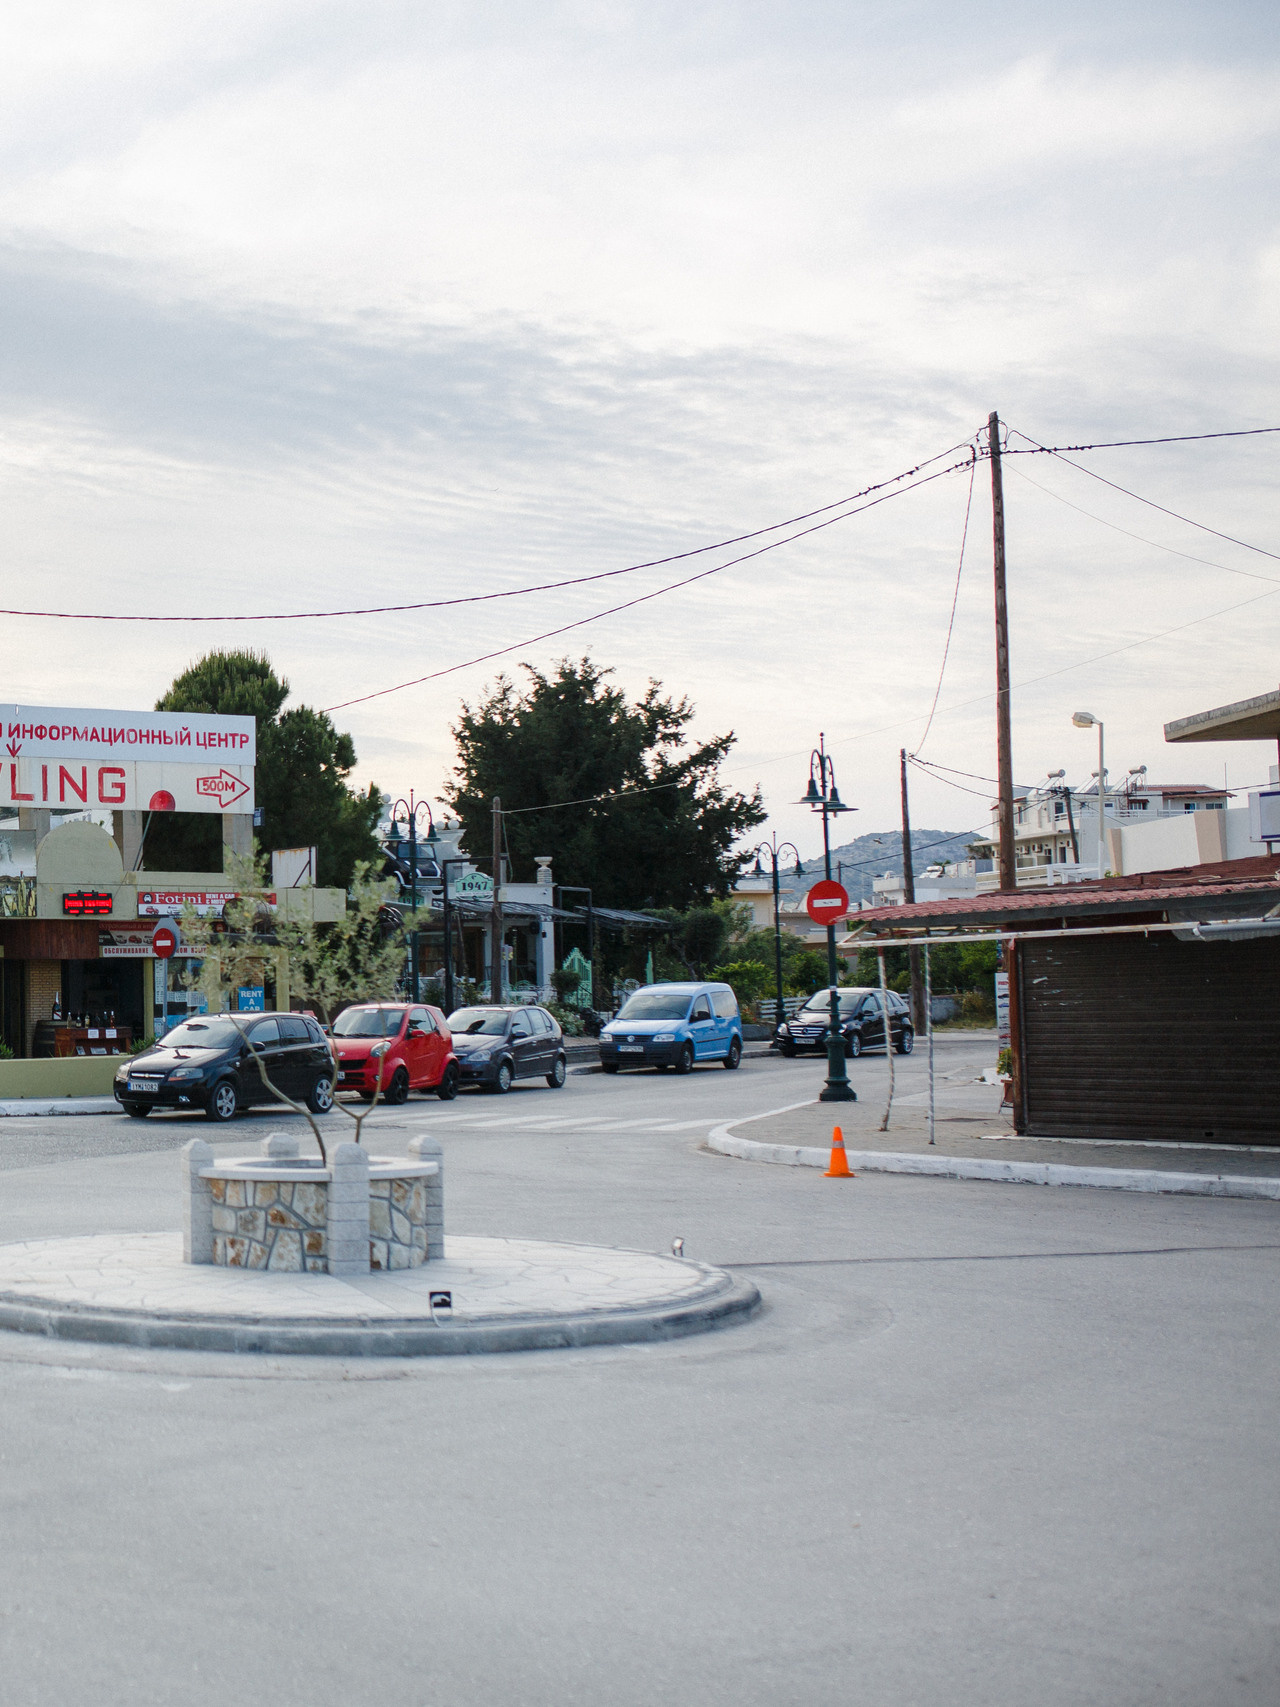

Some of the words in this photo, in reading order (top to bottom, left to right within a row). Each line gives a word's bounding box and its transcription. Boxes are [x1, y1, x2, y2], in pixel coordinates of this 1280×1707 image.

[7, 722, 191, 746] ИНФОРМАЦИОННЫЙ
[196, 731, 250, 750] ЦЕНТР
[462, 882, 488, 890] 1947
[155, 893, 201, 904] Fotini
[240, 990, 263, 998] RENT
